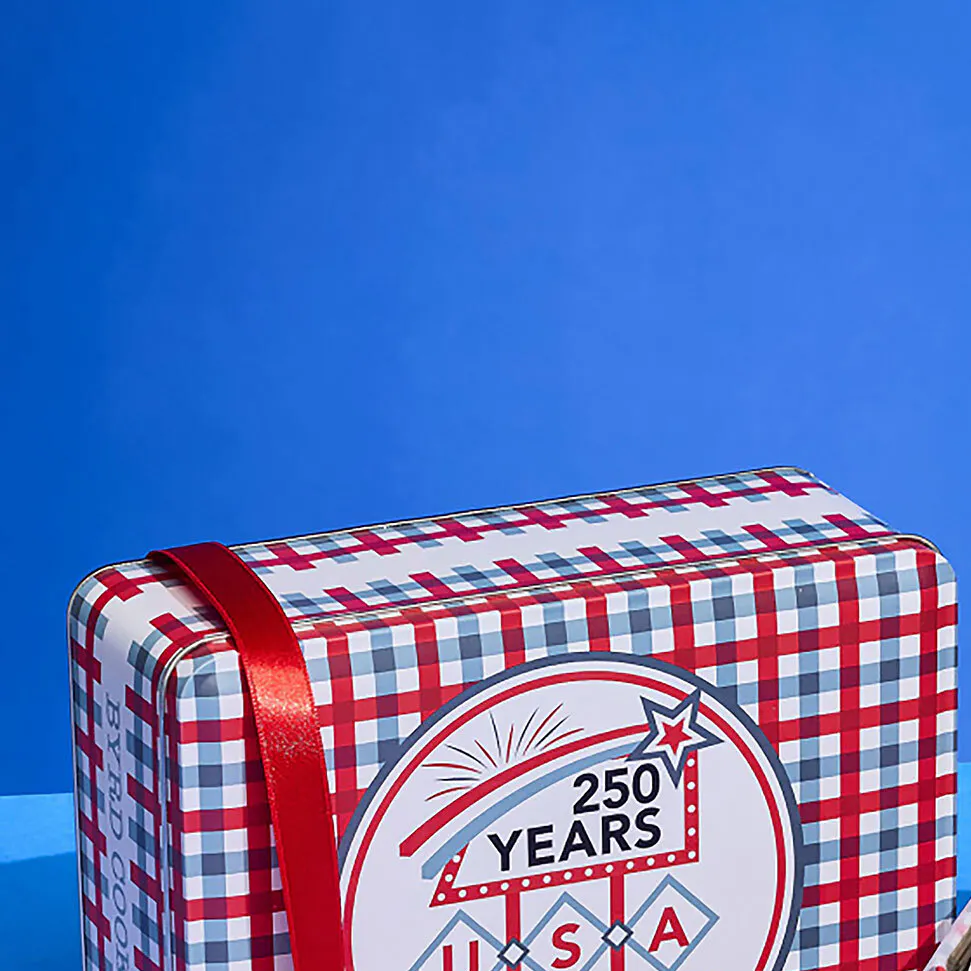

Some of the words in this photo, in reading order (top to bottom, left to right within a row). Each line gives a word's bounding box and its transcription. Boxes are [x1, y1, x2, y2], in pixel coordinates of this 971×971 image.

[105, 691, 124, 841] BYRD
[572, 763, 660, 815] 250
[487, 807, 662, 872] YEARS
